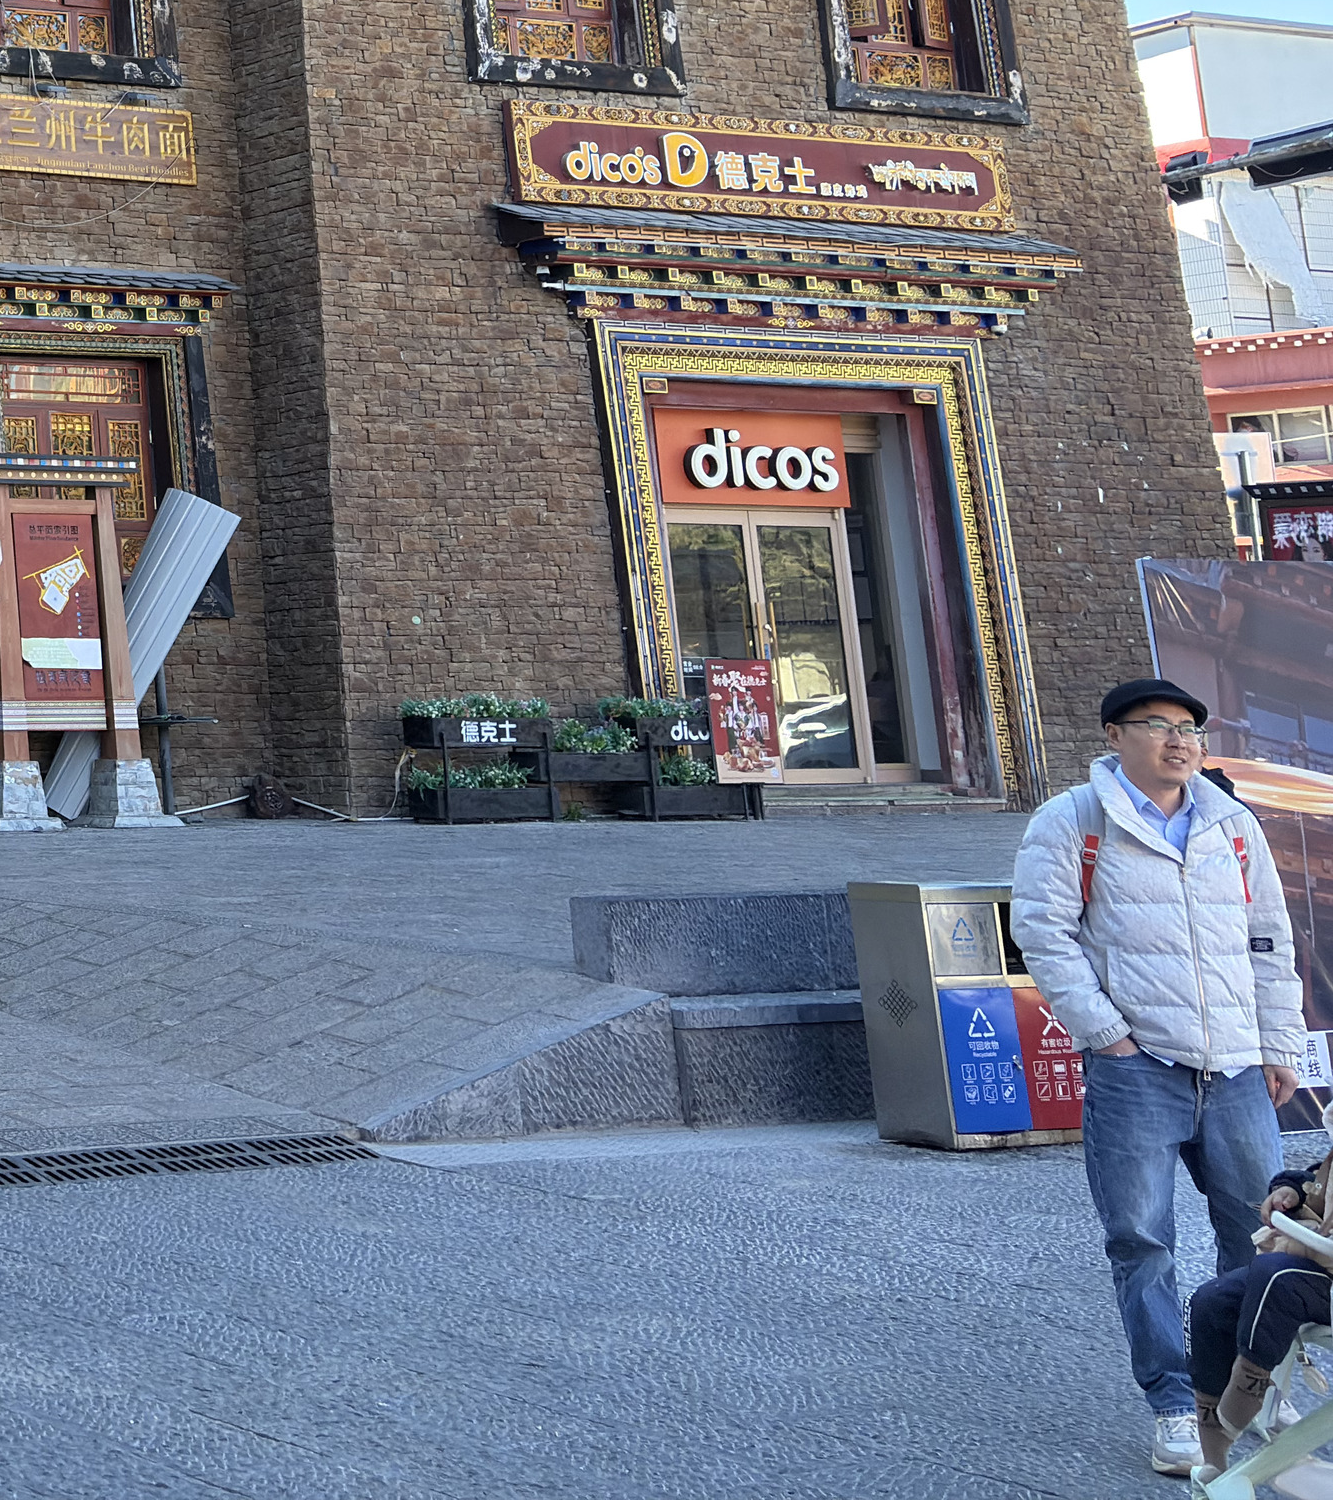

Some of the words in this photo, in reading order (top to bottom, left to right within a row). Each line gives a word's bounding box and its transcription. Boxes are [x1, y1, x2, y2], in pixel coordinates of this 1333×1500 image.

[86, 161, 127, 173] Lanzhou
[128, 163, 150, 174] Beef
[151, 165, 189, 177] Noodles
[715, 150, 817, 194] 德克士
[686, 427, 840, 493] dicos
[460, 719, 518, 744] 德克士
[968, 1041, 999, 1050] 可回收物
[1041, 1038, 1072, 1048] 有害垃圾
